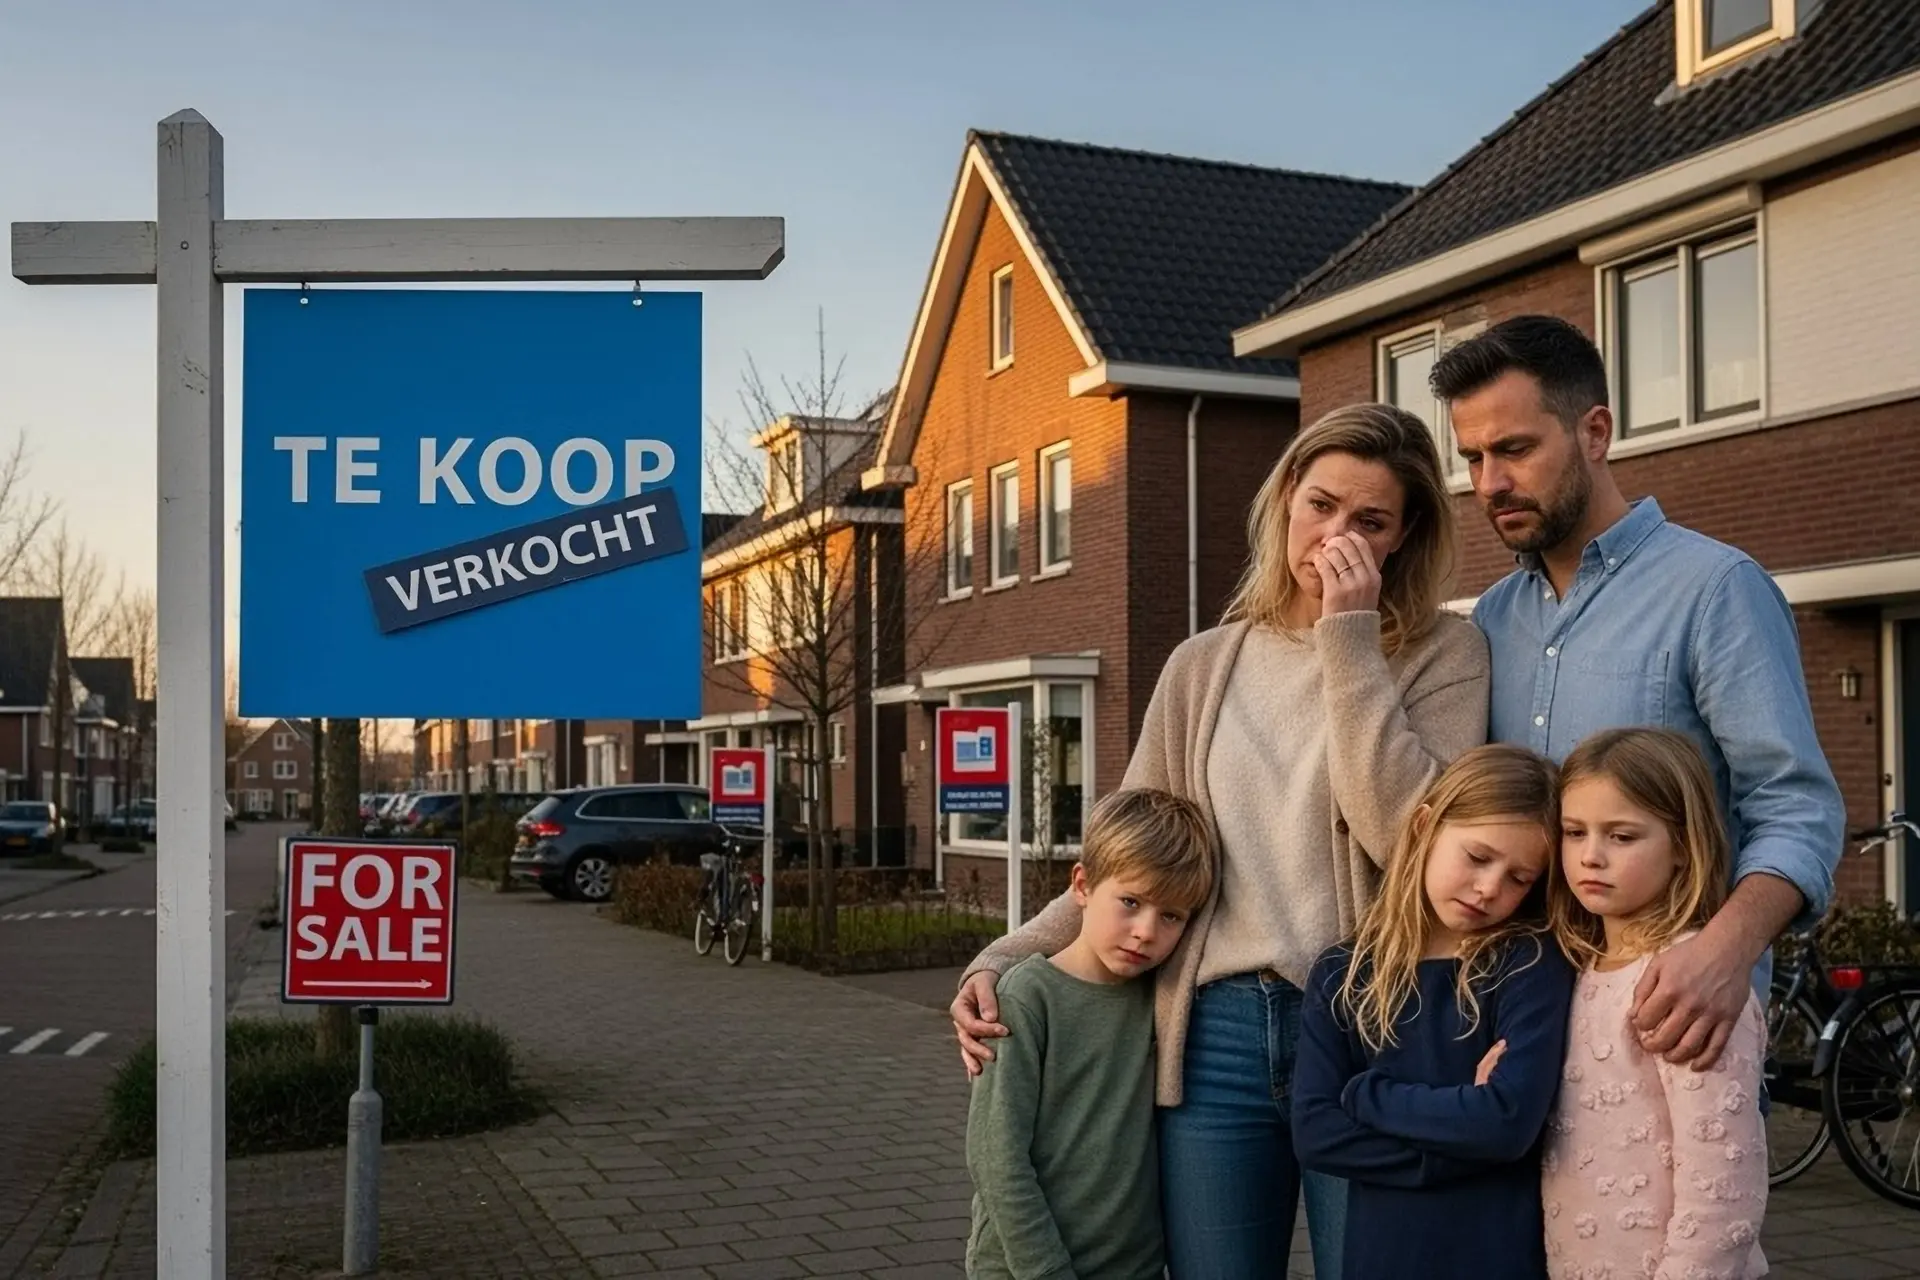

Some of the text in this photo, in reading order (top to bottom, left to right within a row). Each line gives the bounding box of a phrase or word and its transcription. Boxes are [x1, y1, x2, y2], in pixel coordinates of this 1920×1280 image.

[274, 436, 676, 506] TE KOOP
[385, 504, 657, 611] VERKOCHT
[300, 853, 444, 910] FOR
[296, 914, 442, 962] SALE
